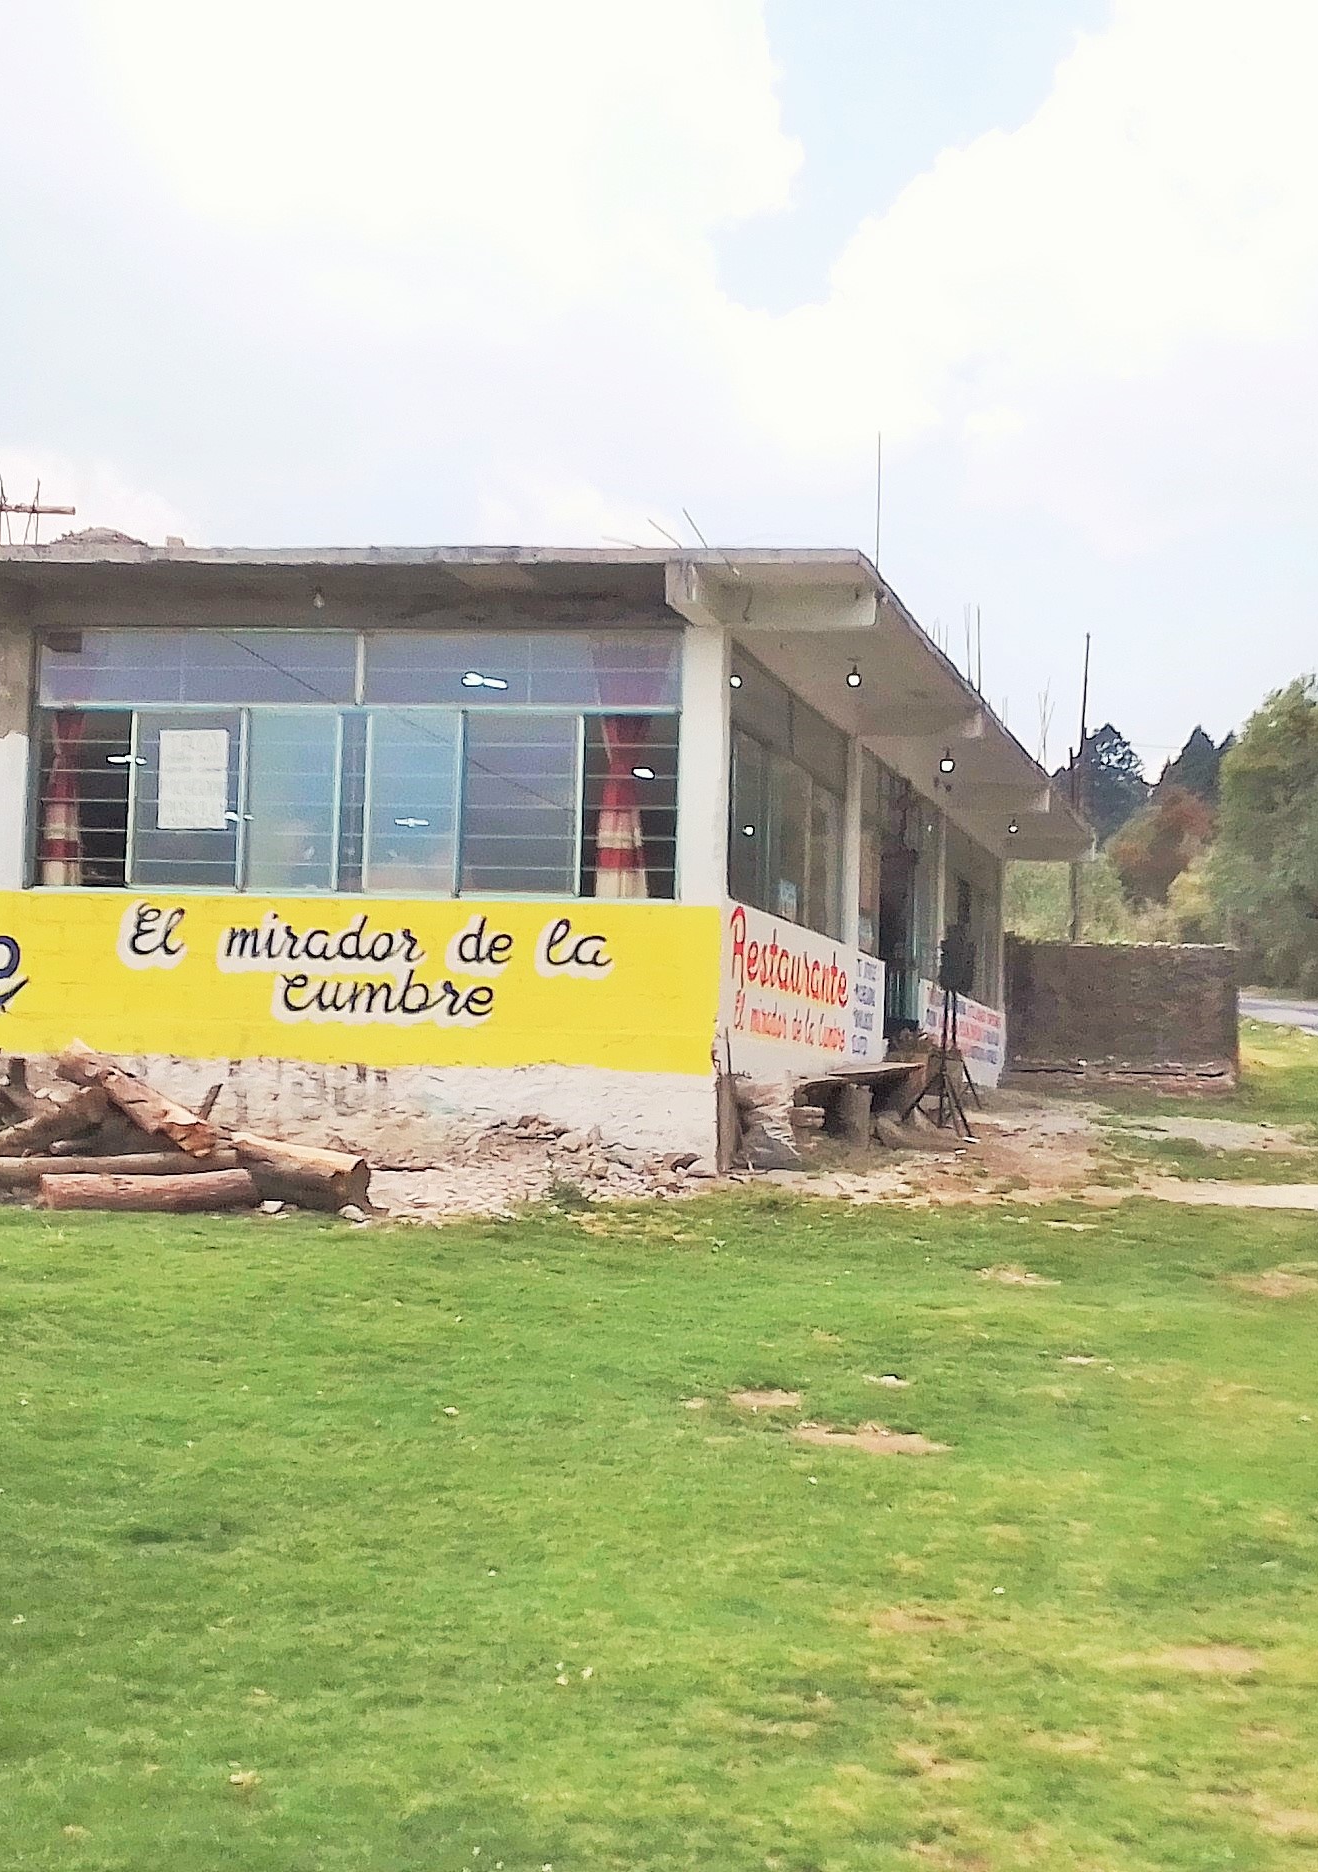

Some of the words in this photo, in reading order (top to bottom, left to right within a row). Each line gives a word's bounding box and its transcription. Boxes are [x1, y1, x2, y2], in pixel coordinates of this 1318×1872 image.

[129, 902, 186, 957] El
[224, 912, 427, 962] mirador
[457, 915, 514, 965] de
[545, 917, 615, 967] la
[729, 905, 849, 1008] Restaurante
